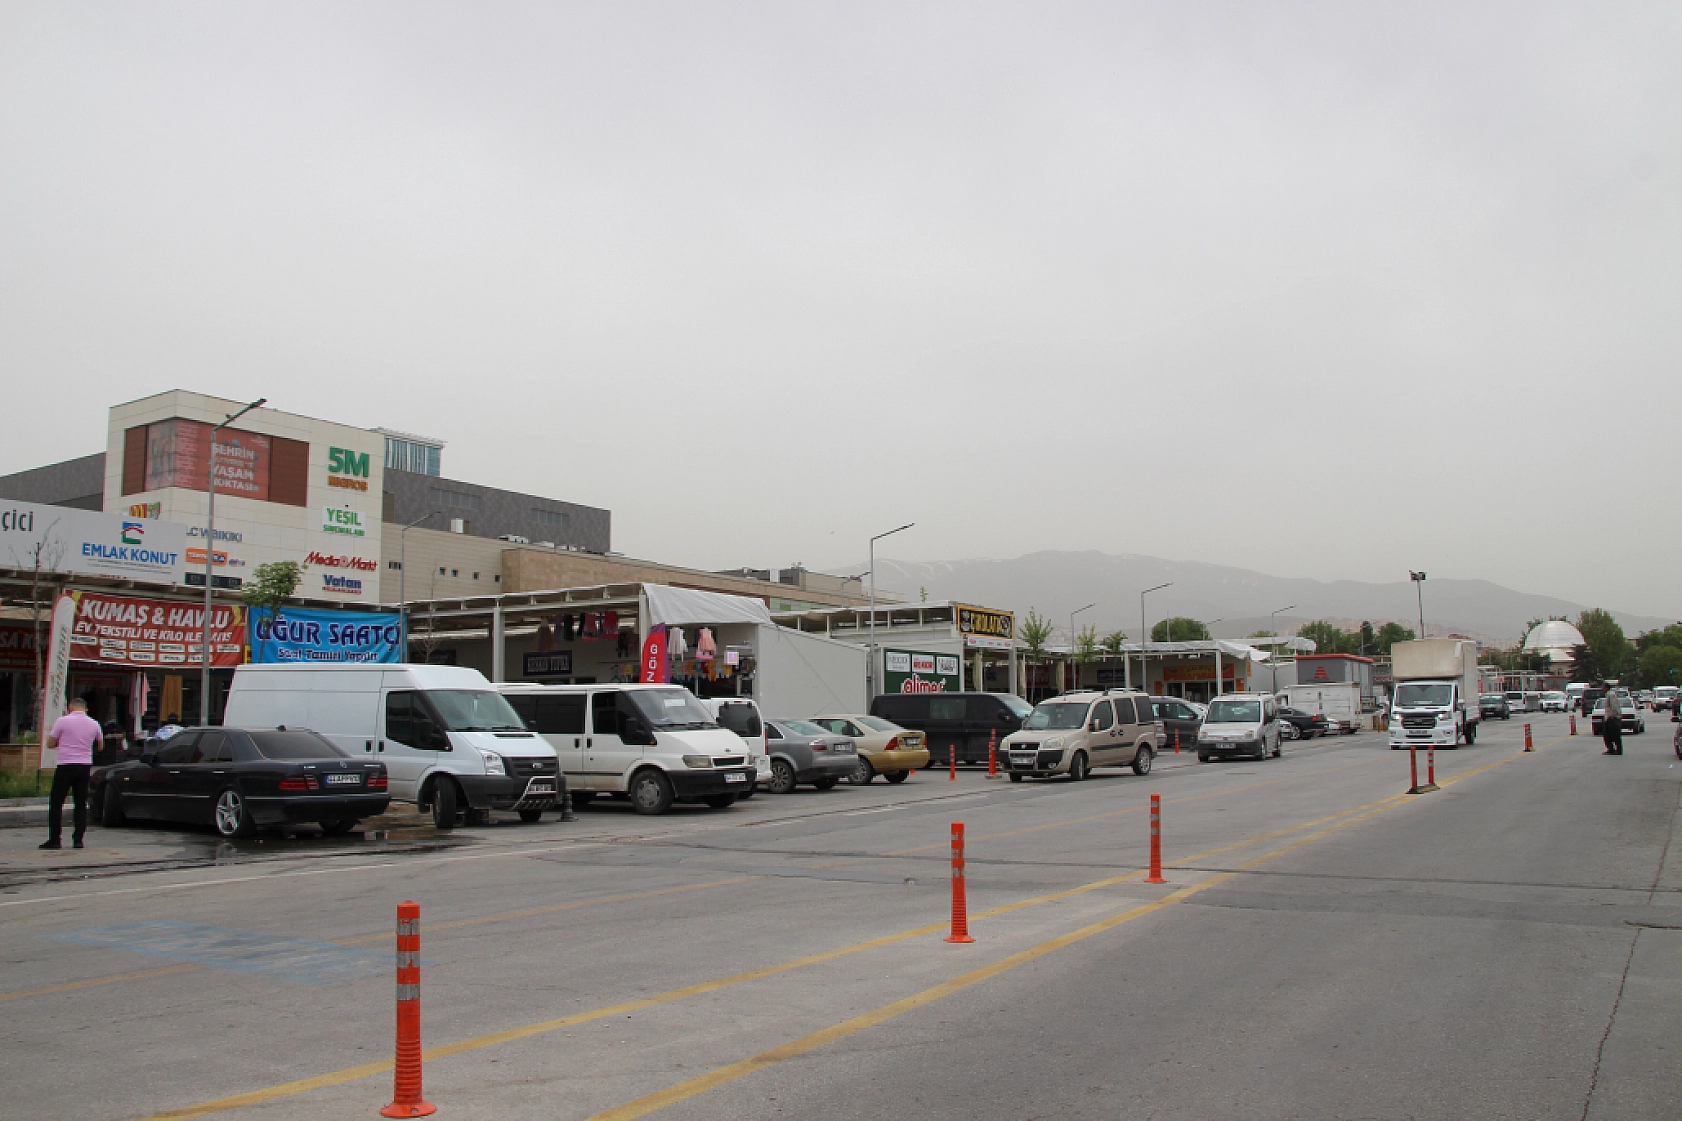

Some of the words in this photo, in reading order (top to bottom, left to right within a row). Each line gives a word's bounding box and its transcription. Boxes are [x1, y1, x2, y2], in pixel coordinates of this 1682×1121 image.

[328, 446, 370, 477] 5M
[82, 542, 128, 560] EMLAK
[131, 547, 178, 566] KONUT
[323, 574, 362, 589] Vatan
[81, 599, 150, 627] KUMAŞ
[152, 607, 166, 625] &
[168, 608, 231, 629] HAVLU
[74, 621, 92, 634] EV
[143, 628, 158, 640] VE
